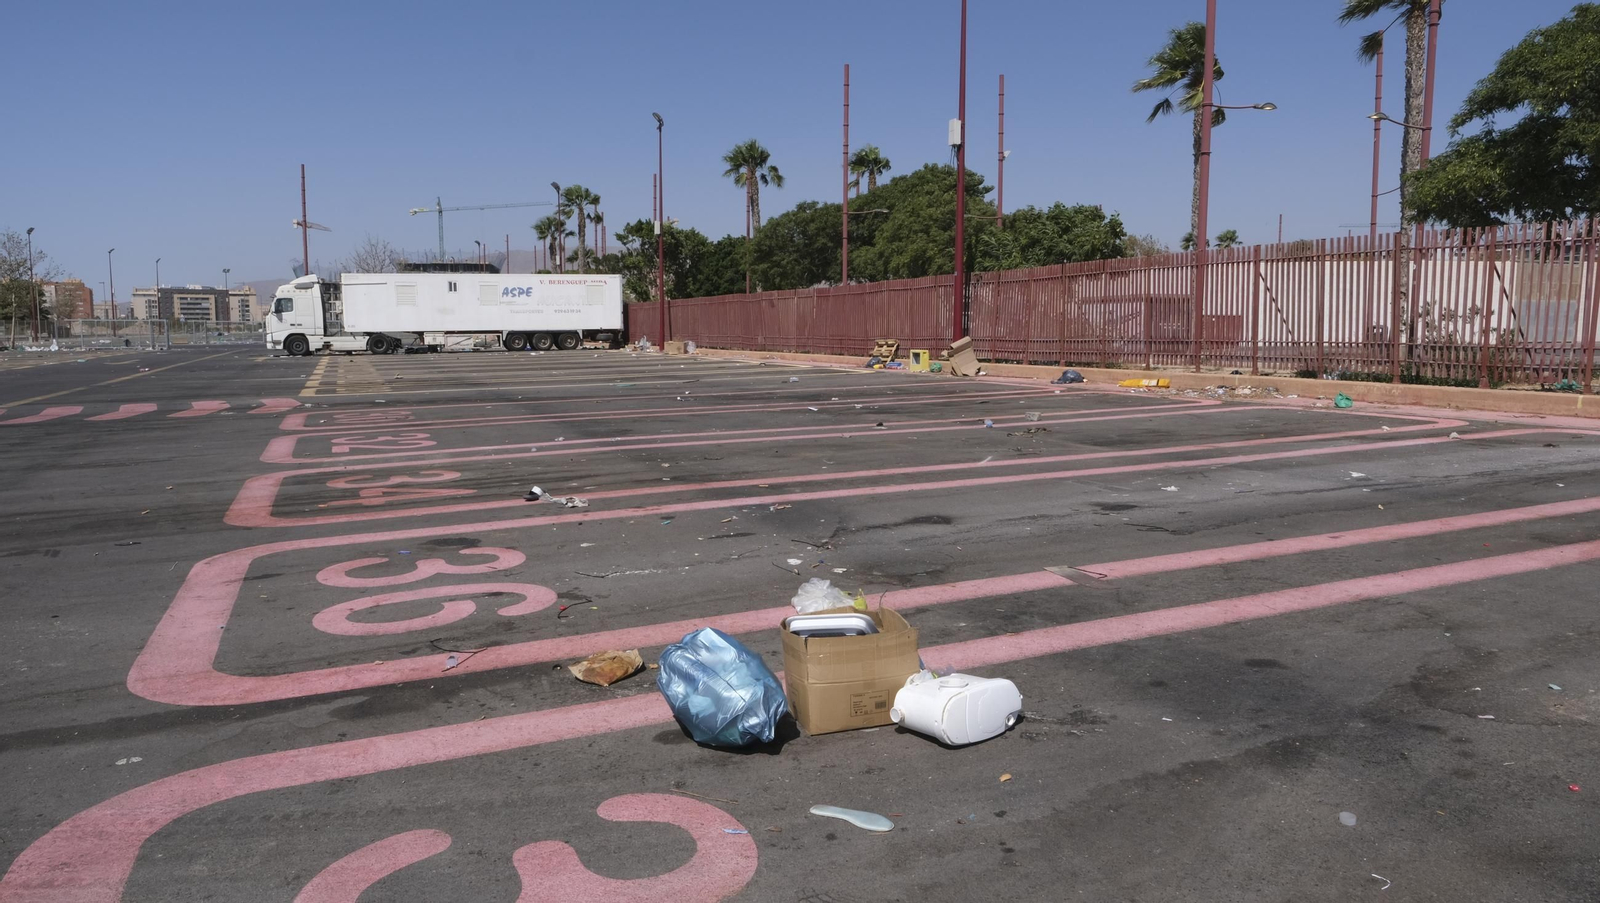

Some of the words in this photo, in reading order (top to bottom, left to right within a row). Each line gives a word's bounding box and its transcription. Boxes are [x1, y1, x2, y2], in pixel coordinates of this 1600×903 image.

[501, 286, 533, 298] ASPE
[331, 433, 438, 454] 32
[325, 470, 478, 506] 34
[312, 547, 557, 636] 36
